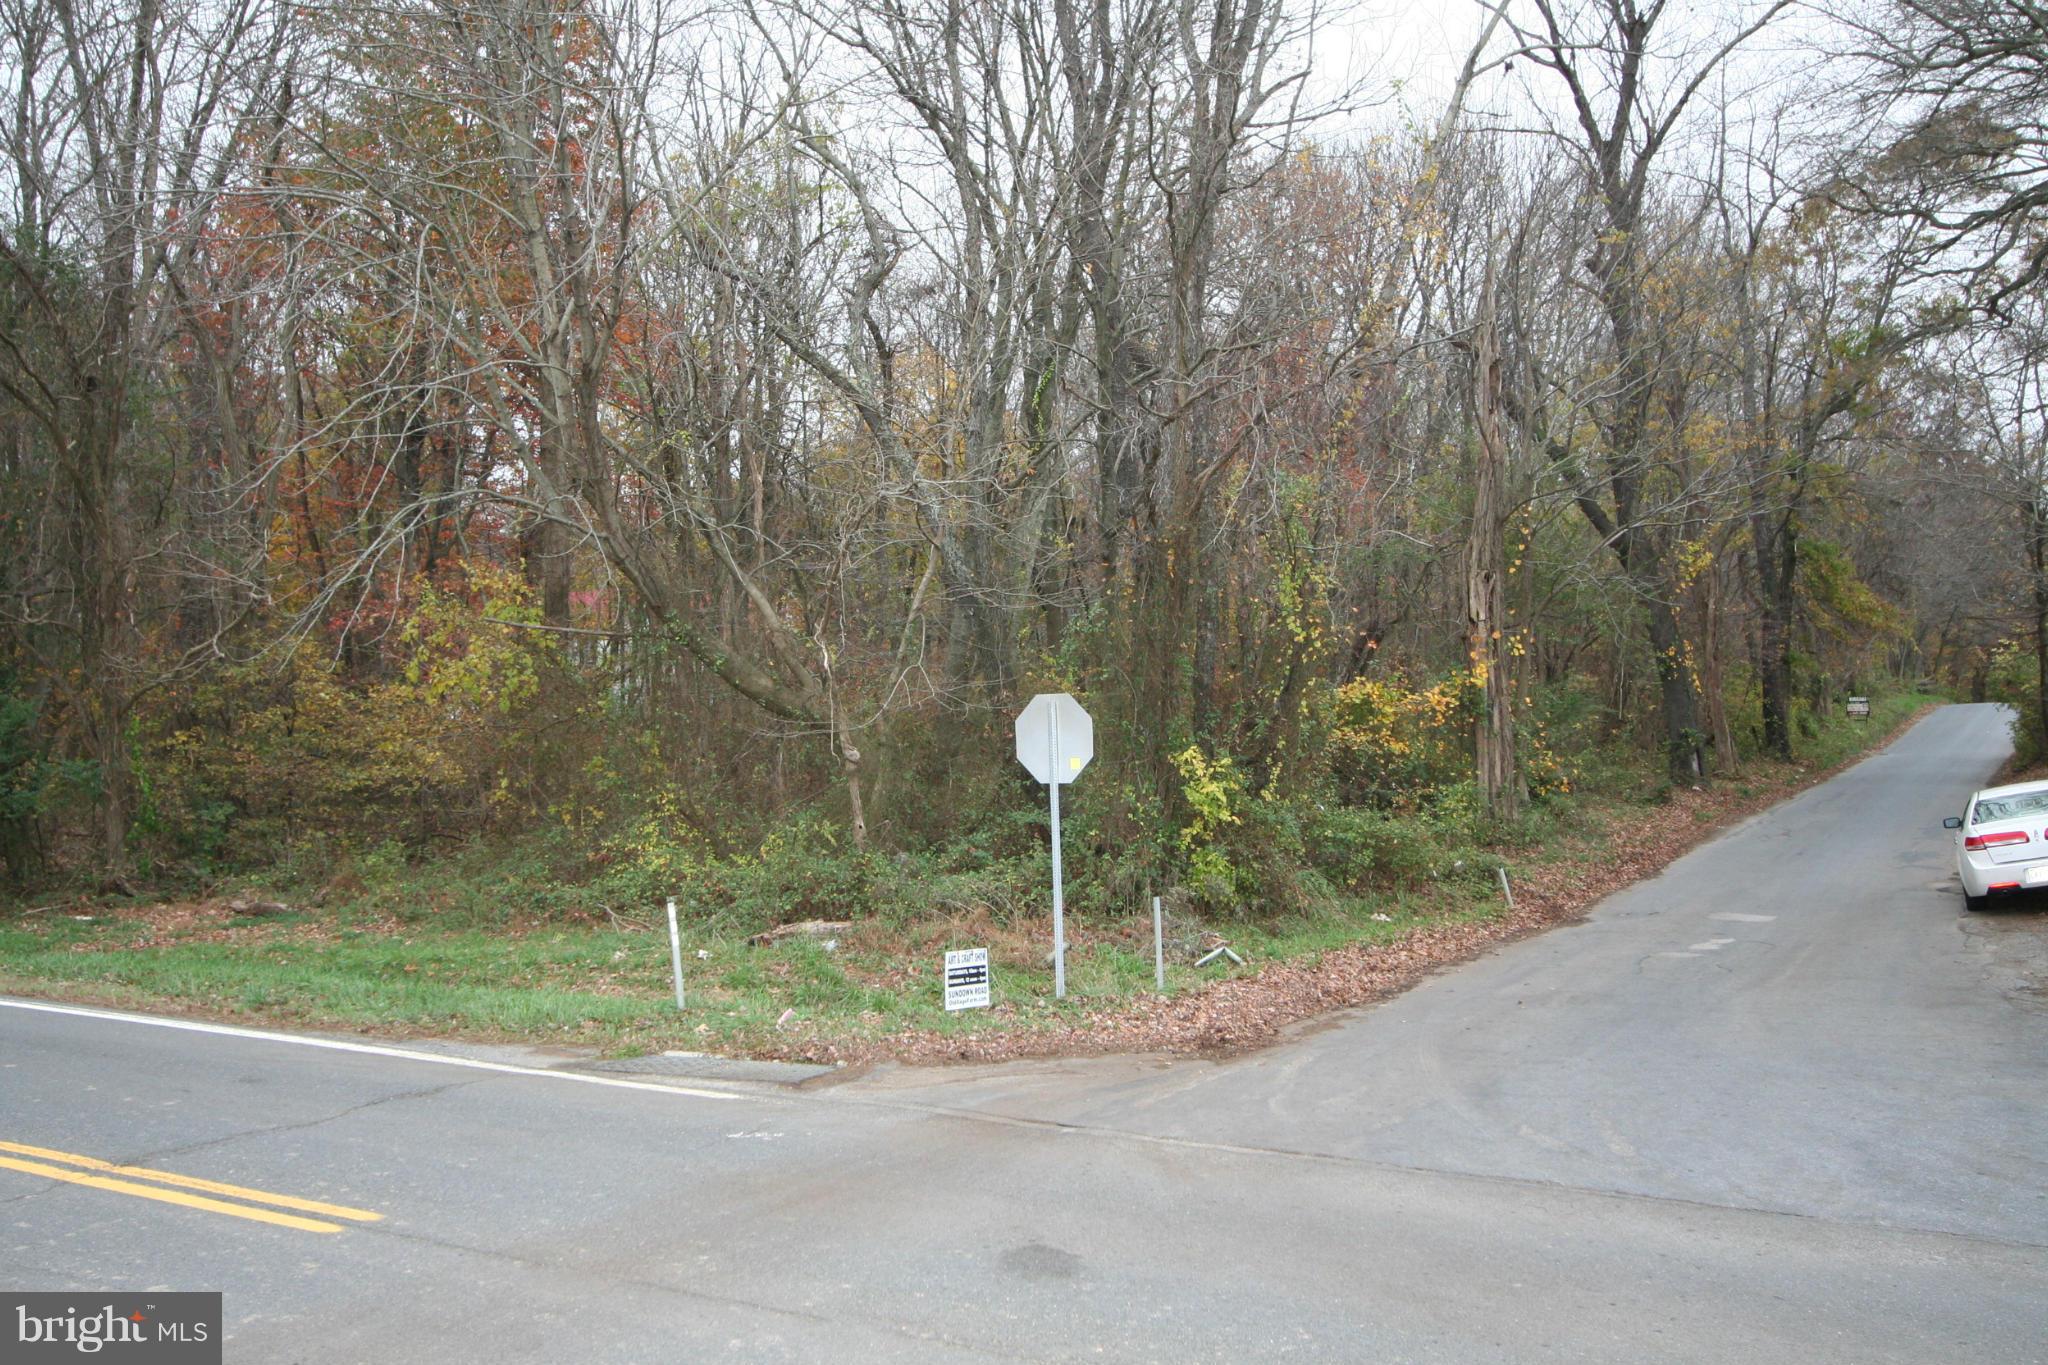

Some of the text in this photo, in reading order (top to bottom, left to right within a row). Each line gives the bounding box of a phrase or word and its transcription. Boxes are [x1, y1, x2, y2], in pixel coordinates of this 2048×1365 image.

[975, 952, 986, 962] SHOW
[948, 986, 987, 998] SUNDOWN ROAD
